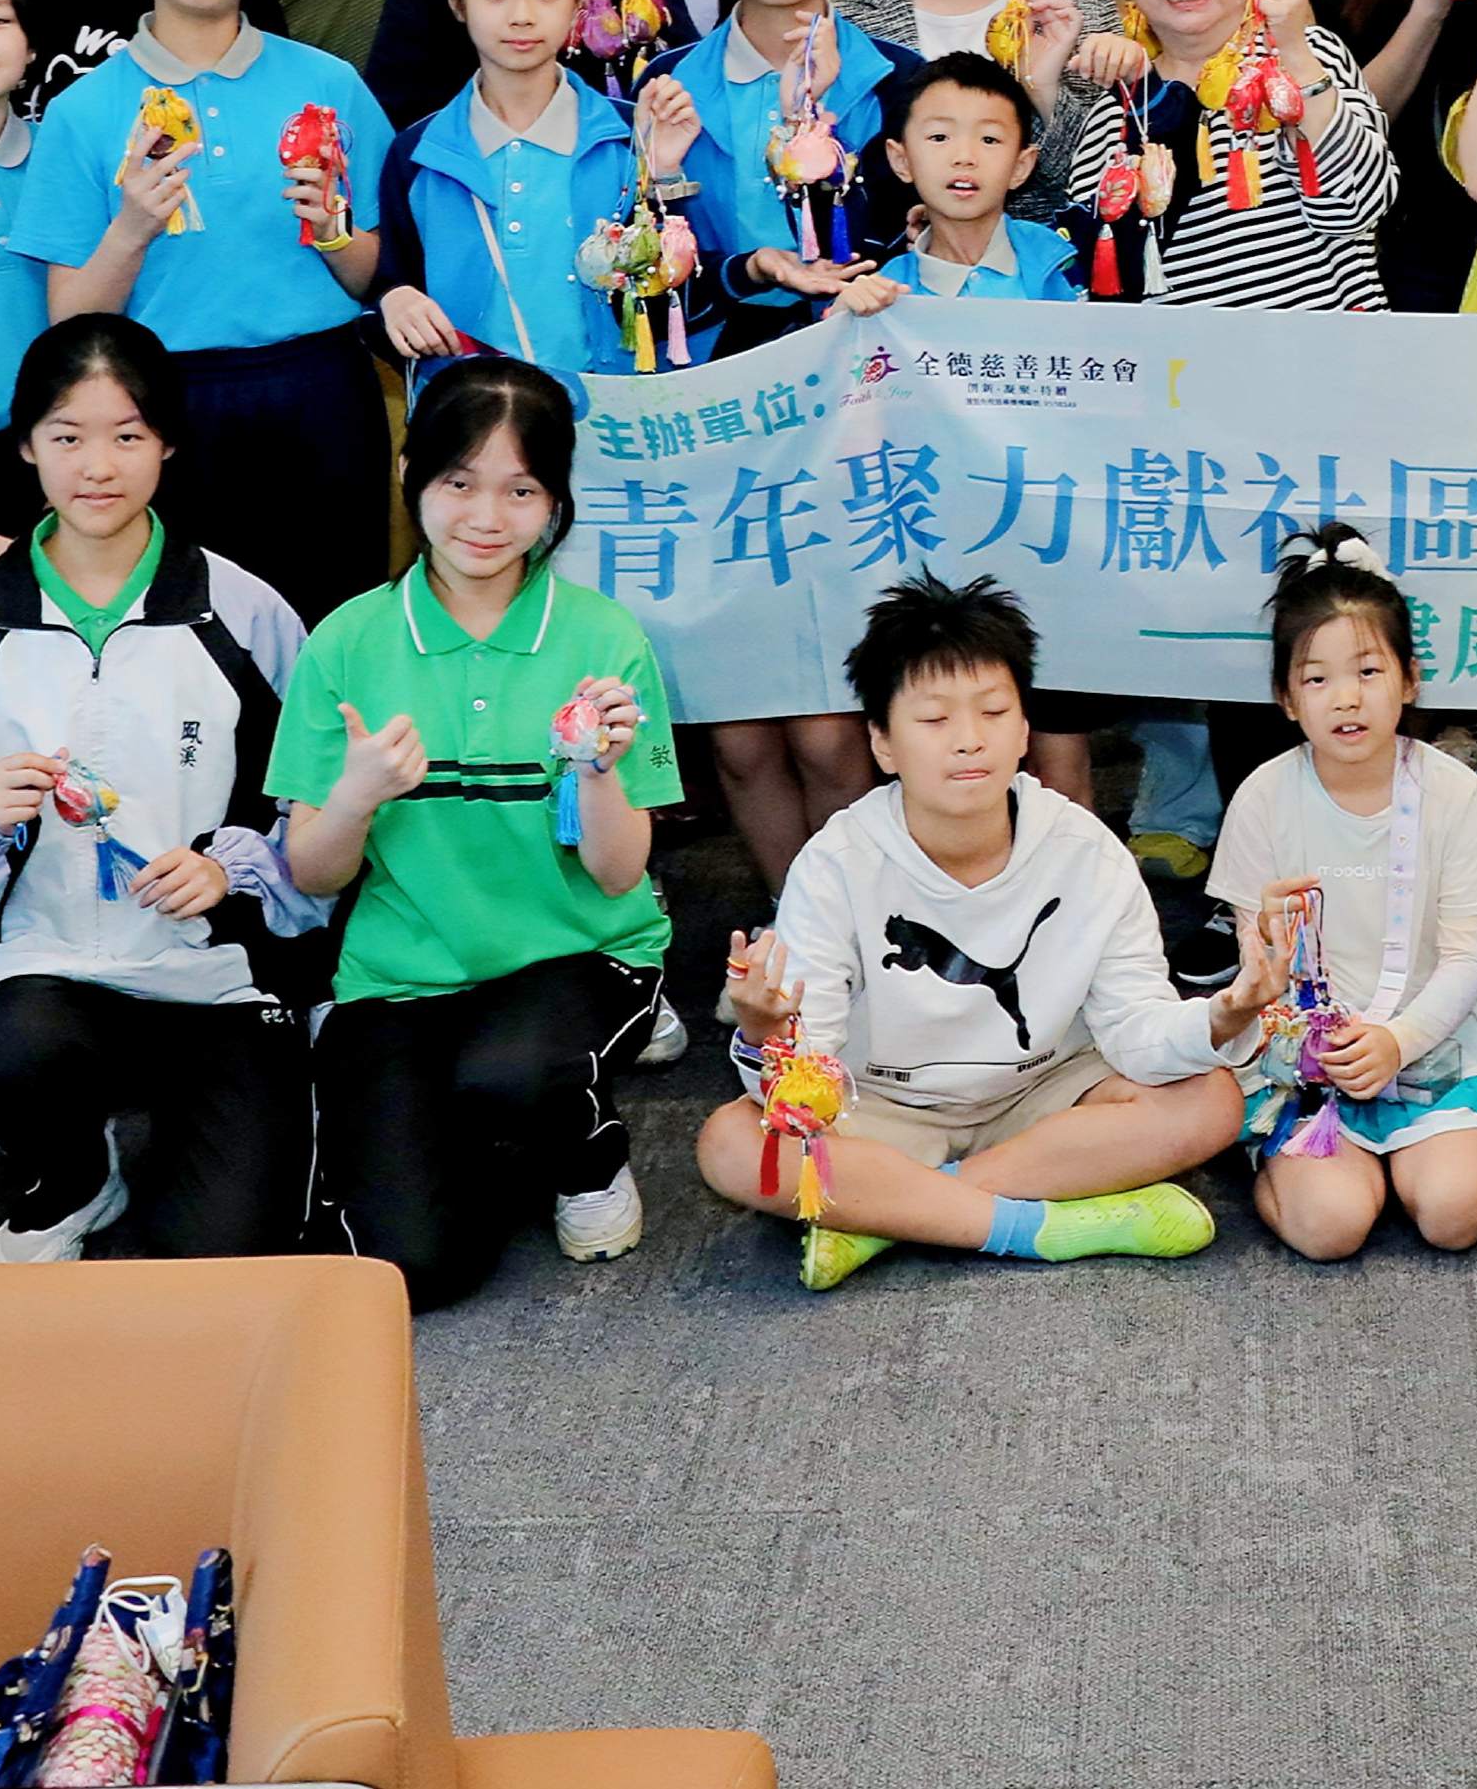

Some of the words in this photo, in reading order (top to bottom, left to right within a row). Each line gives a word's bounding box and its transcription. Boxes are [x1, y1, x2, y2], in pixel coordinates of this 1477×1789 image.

[914, 350, 1139, 384] 全德慈善基金會
[180, 719, 204, 769] 鳳溪
[1317, 862, 1384, 881] moodyt
